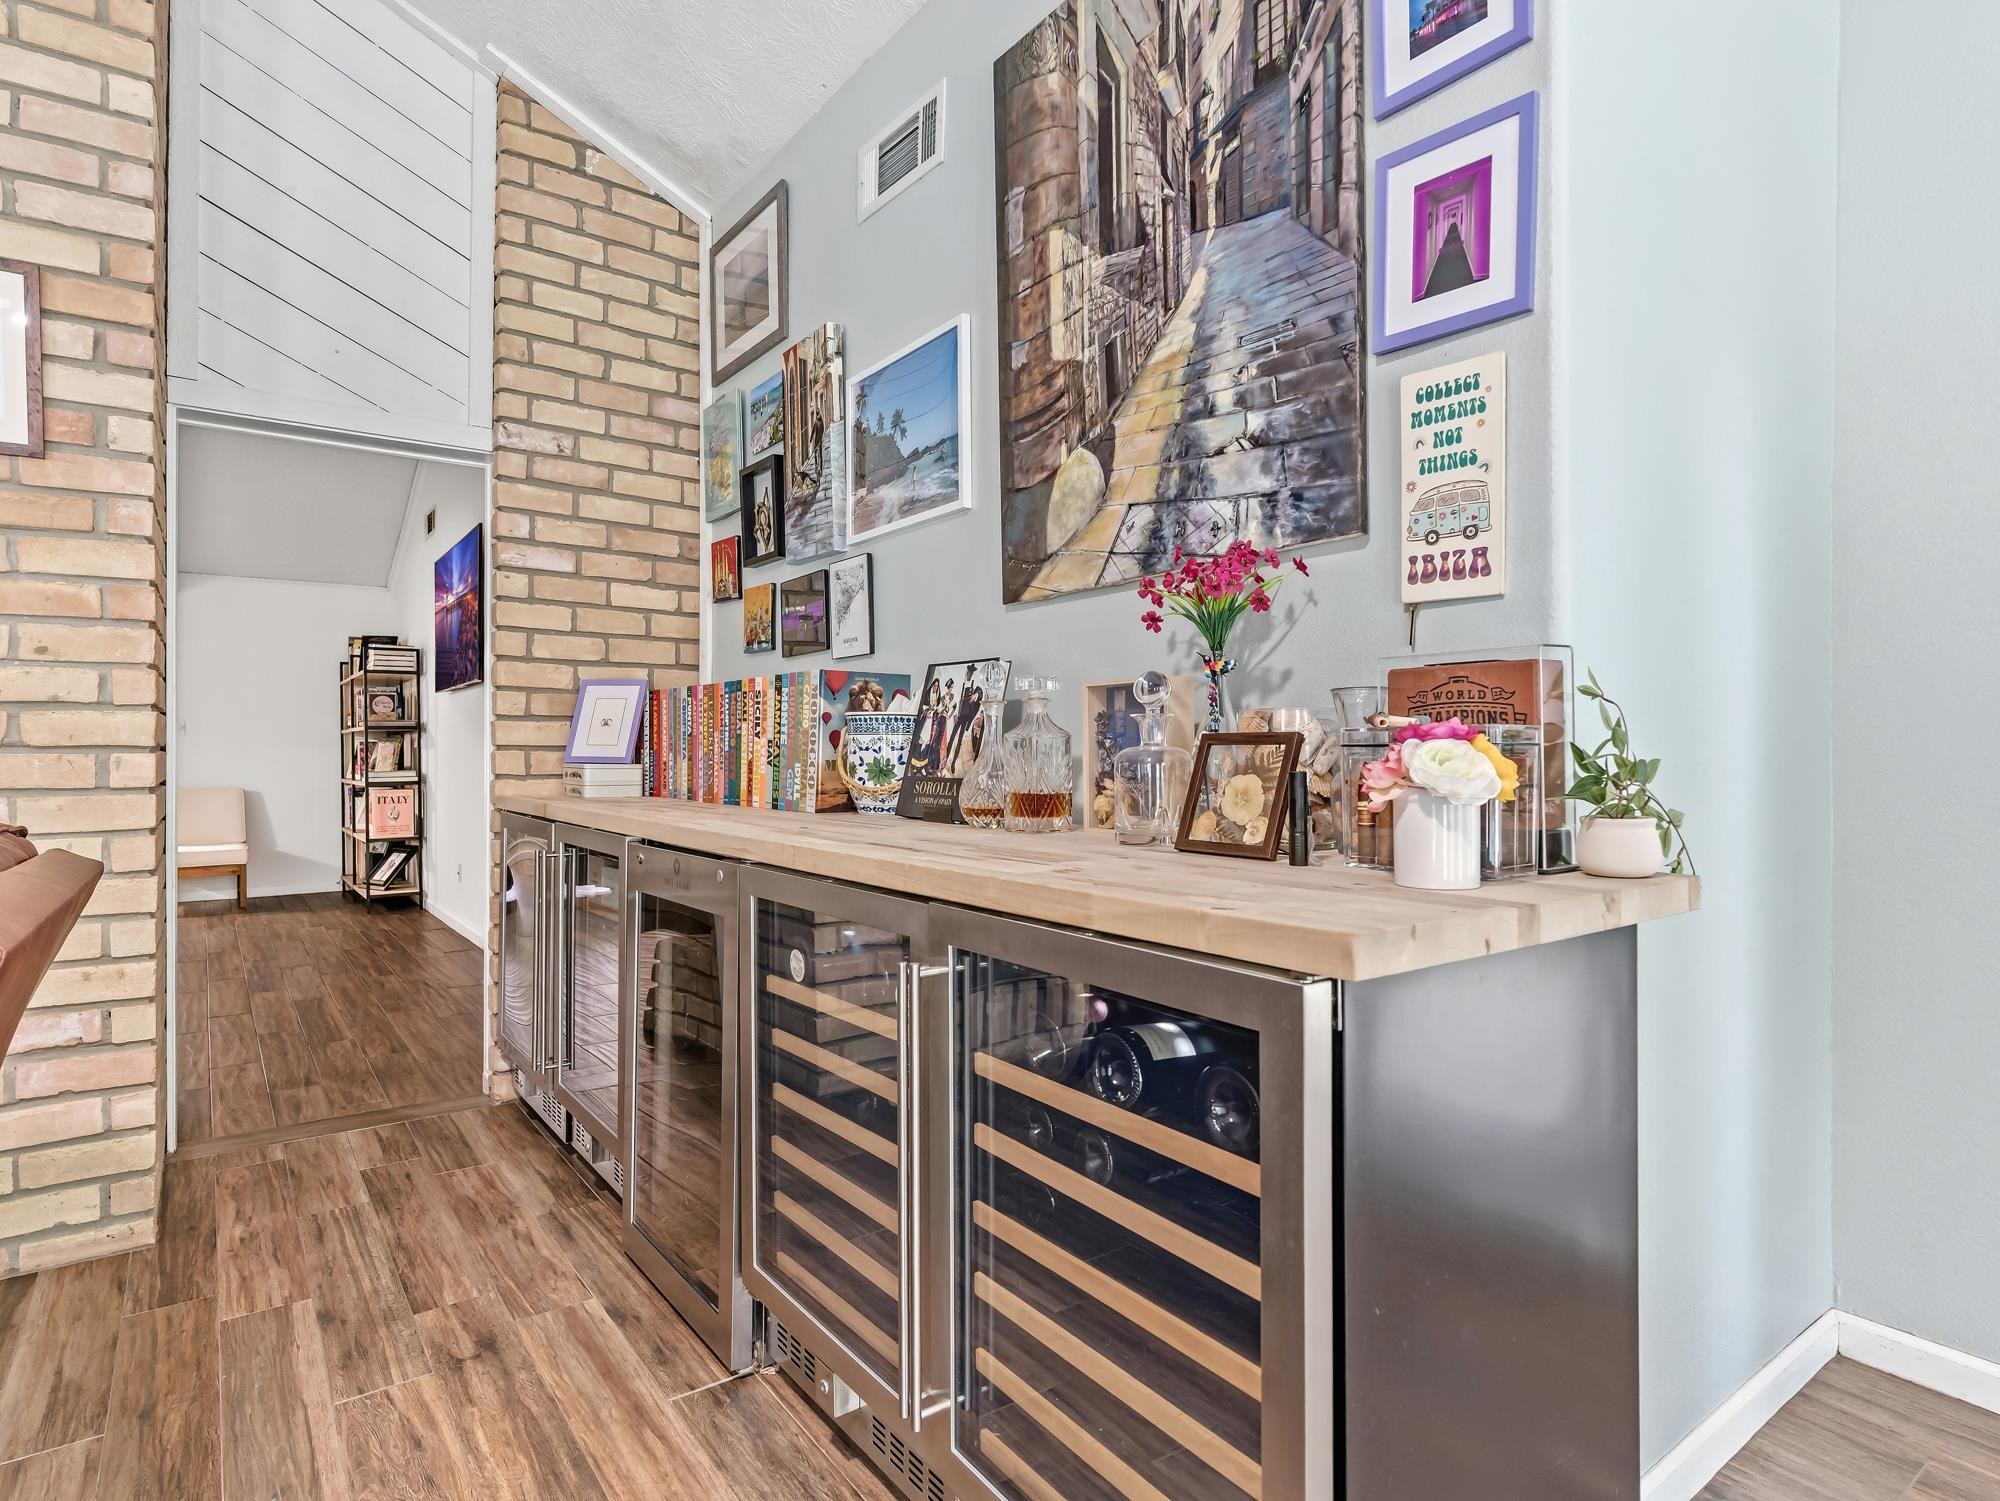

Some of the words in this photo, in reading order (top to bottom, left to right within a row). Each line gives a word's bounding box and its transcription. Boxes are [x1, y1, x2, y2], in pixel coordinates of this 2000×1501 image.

[1415, 372, 1481, 405] COLLECT
[1410, 396, 1487, 429] MOMENTS
[1433, 426, 1464, 449] NOT
[1418, 448, 1478, 476] THINGS
[1406, 546, 1492, 586] IBIZA
[802, 684, 810, 728] CAIRO
[1432, 688, 1487, 702] WORLD
[780, 687, 788, 745] MONTE
[1416, 709, 1509, 725] HAMPIONS
[808, 684, 818, 790] MOROCCO
[800, 729, 808, 801] ETERNAL
[377, 795, 409, 805] ITALY
[914, 780, 957, 796] SOROLLA
[918, 796, 934, 804] VISION
